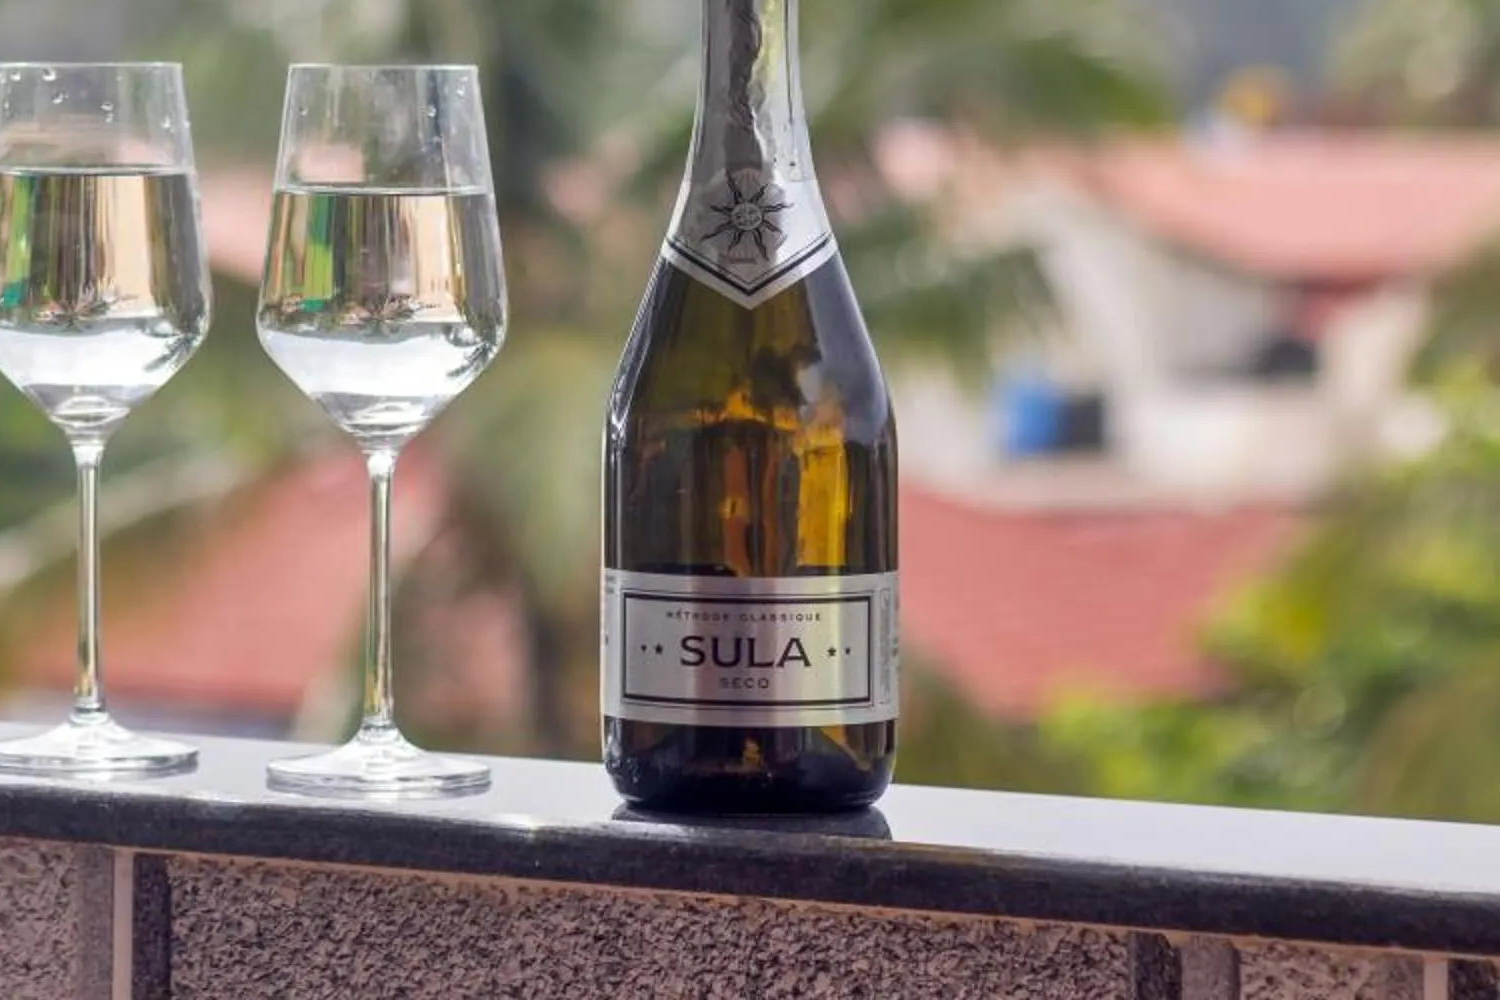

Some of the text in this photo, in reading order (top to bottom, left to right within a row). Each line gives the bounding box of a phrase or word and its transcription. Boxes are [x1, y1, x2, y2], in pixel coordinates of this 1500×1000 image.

[739, 611, 821, 622] CLASSIQUE
[680, 635, 812, 668] SULA
[719, 677, 769, 689] SECO
